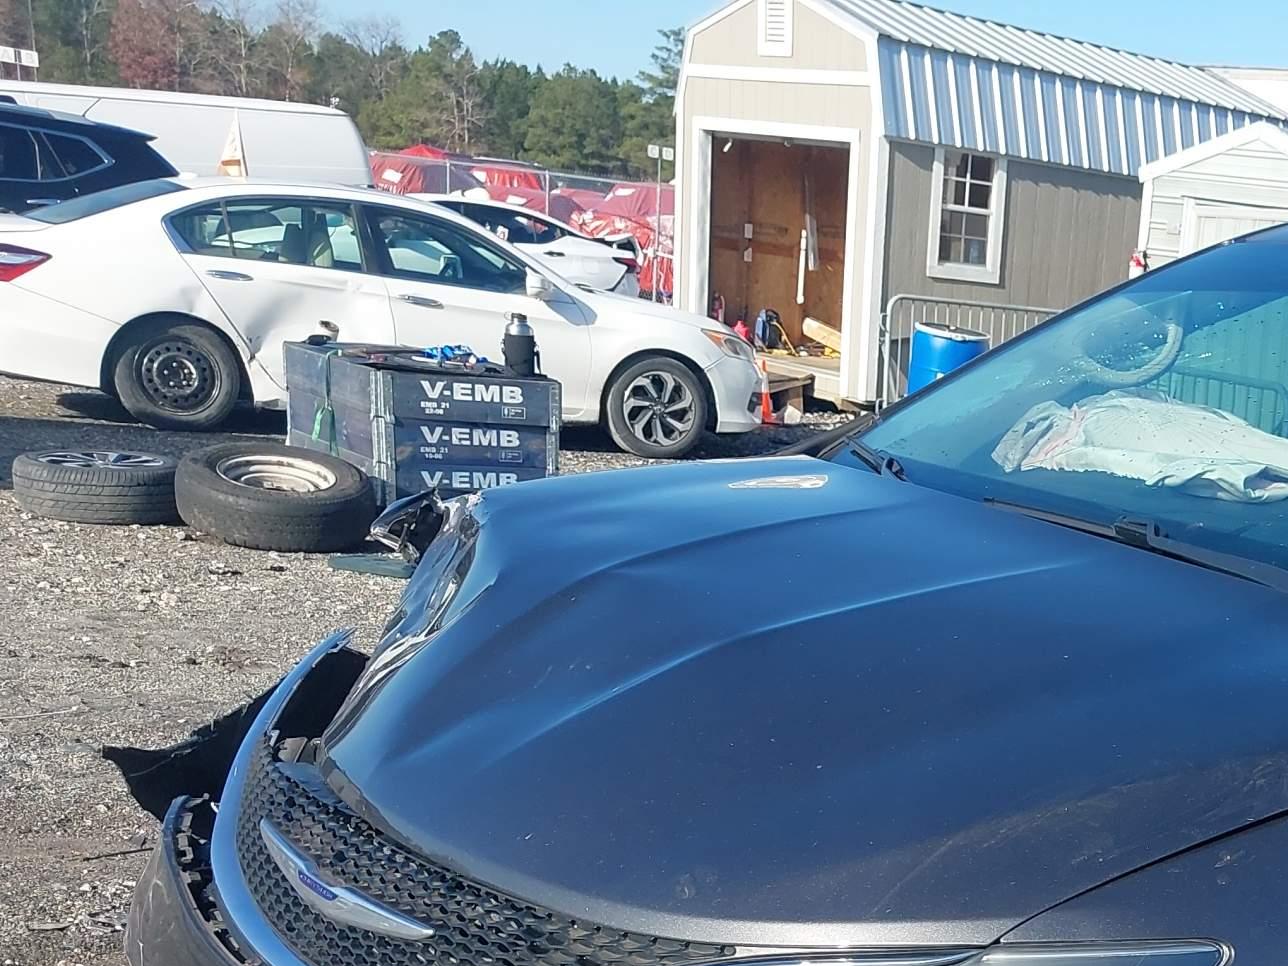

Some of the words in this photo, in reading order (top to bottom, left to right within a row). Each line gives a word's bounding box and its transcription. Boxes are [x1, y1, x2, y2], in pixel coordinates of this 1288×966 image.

[420, 380, 524, 404] V-EMB
[420, 426, 520, 447] V-EMB
[420, 470, 518, 489] V-EMB
